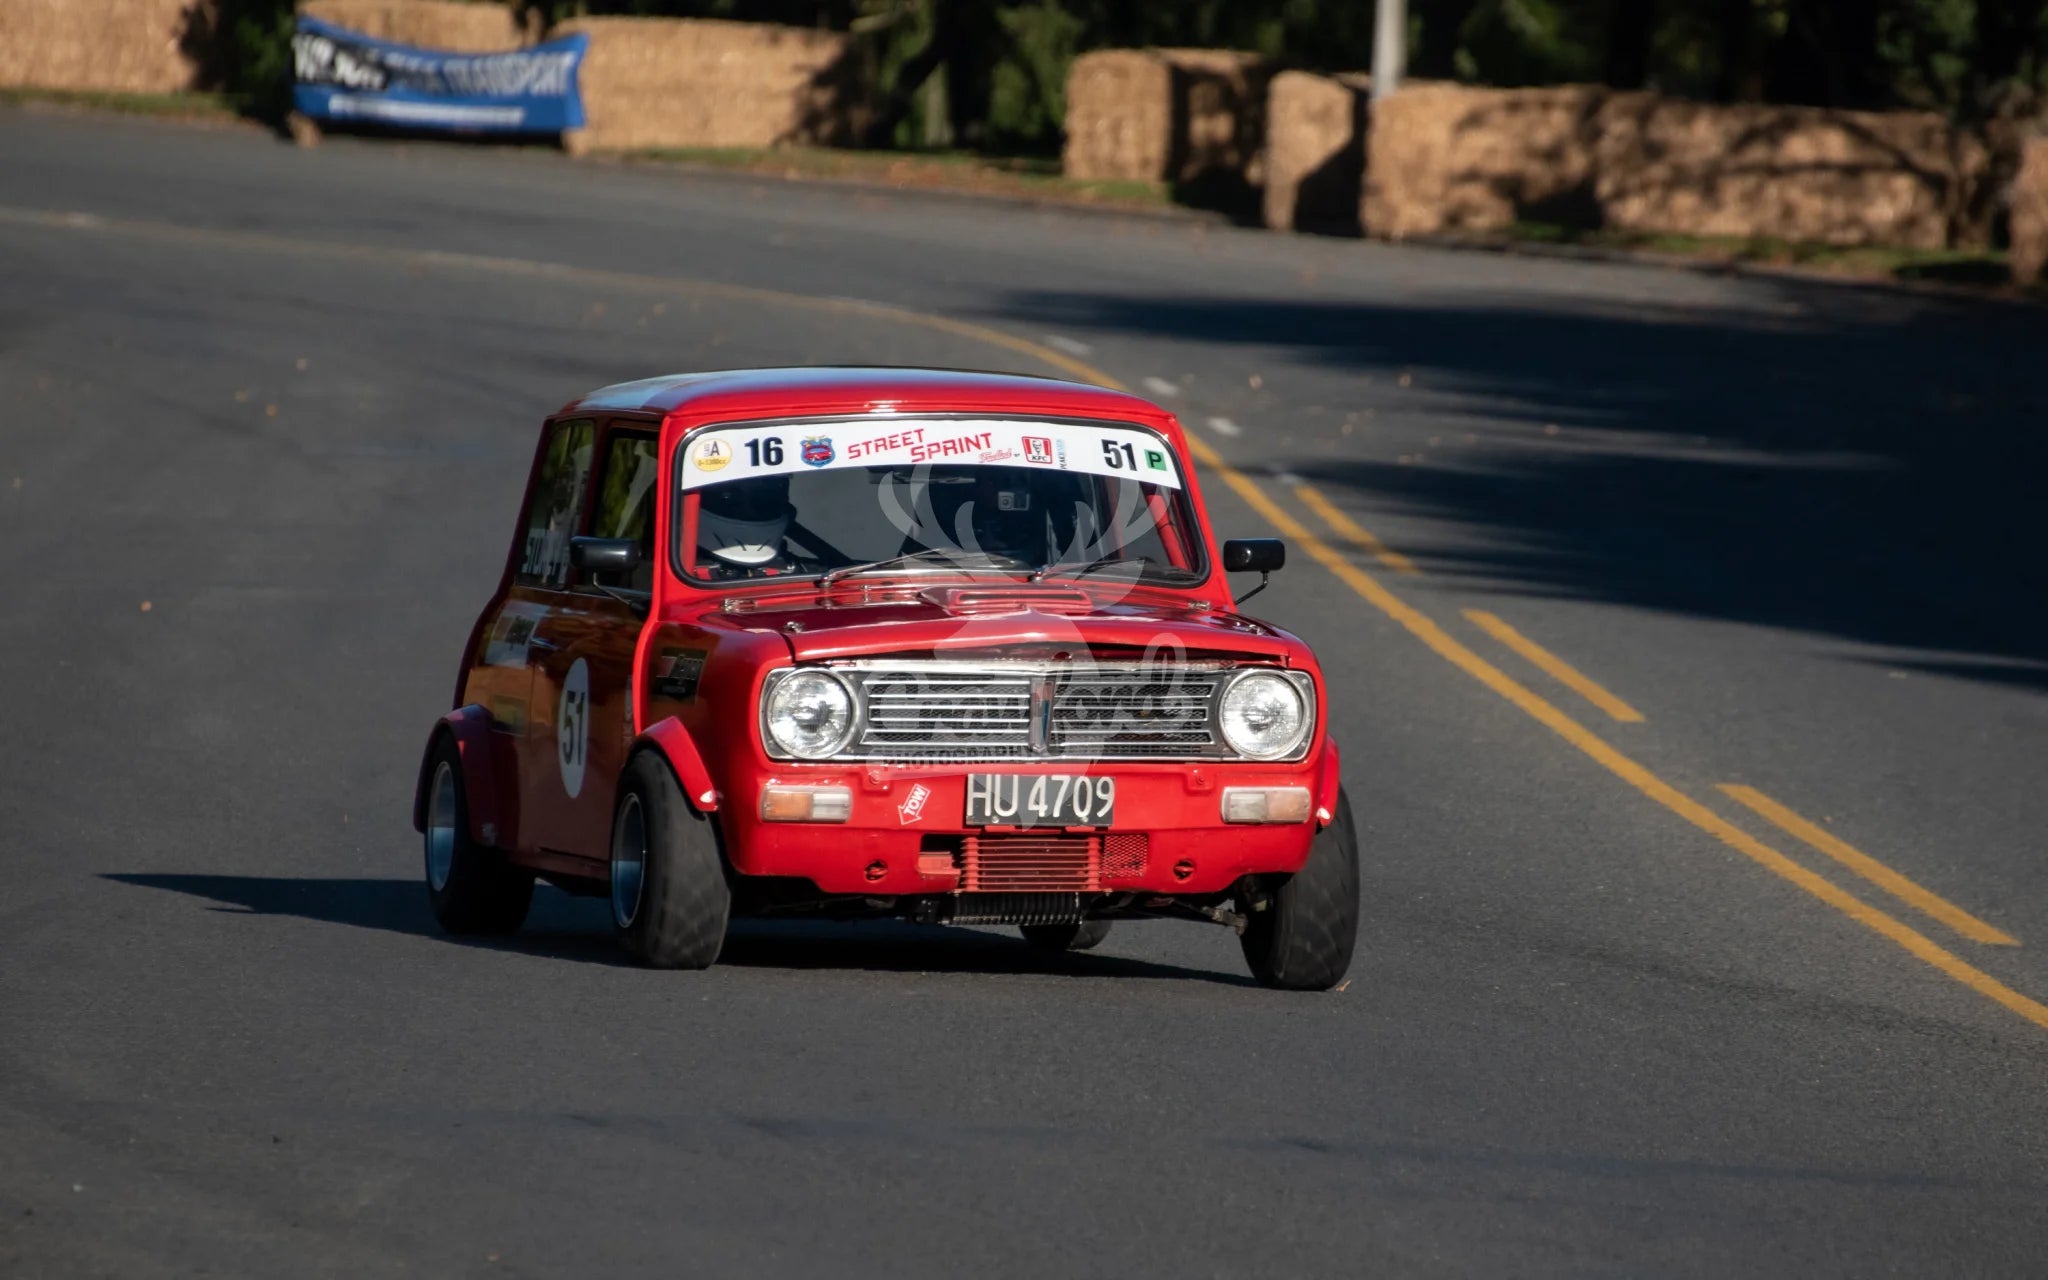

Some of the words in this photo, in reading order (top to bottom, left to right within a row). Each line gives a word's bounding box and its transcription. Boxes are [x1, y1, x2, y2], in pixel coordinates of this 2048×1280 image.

[710, 440, 720, 456] A
[744, 436, 784, 467] 16
[848, 428, 924, 459] STREET
[911, 432, 991, 463] SPRINT
[1101, 439, 1137, 471] 51
[1148, 451, 1162, 468] P
[562, 690, 586, 766] 51
[903, 786, 926, 816] TOW
[967, 773, 1019, 817] HU
[1028, 774, 1115, 818] 4709
